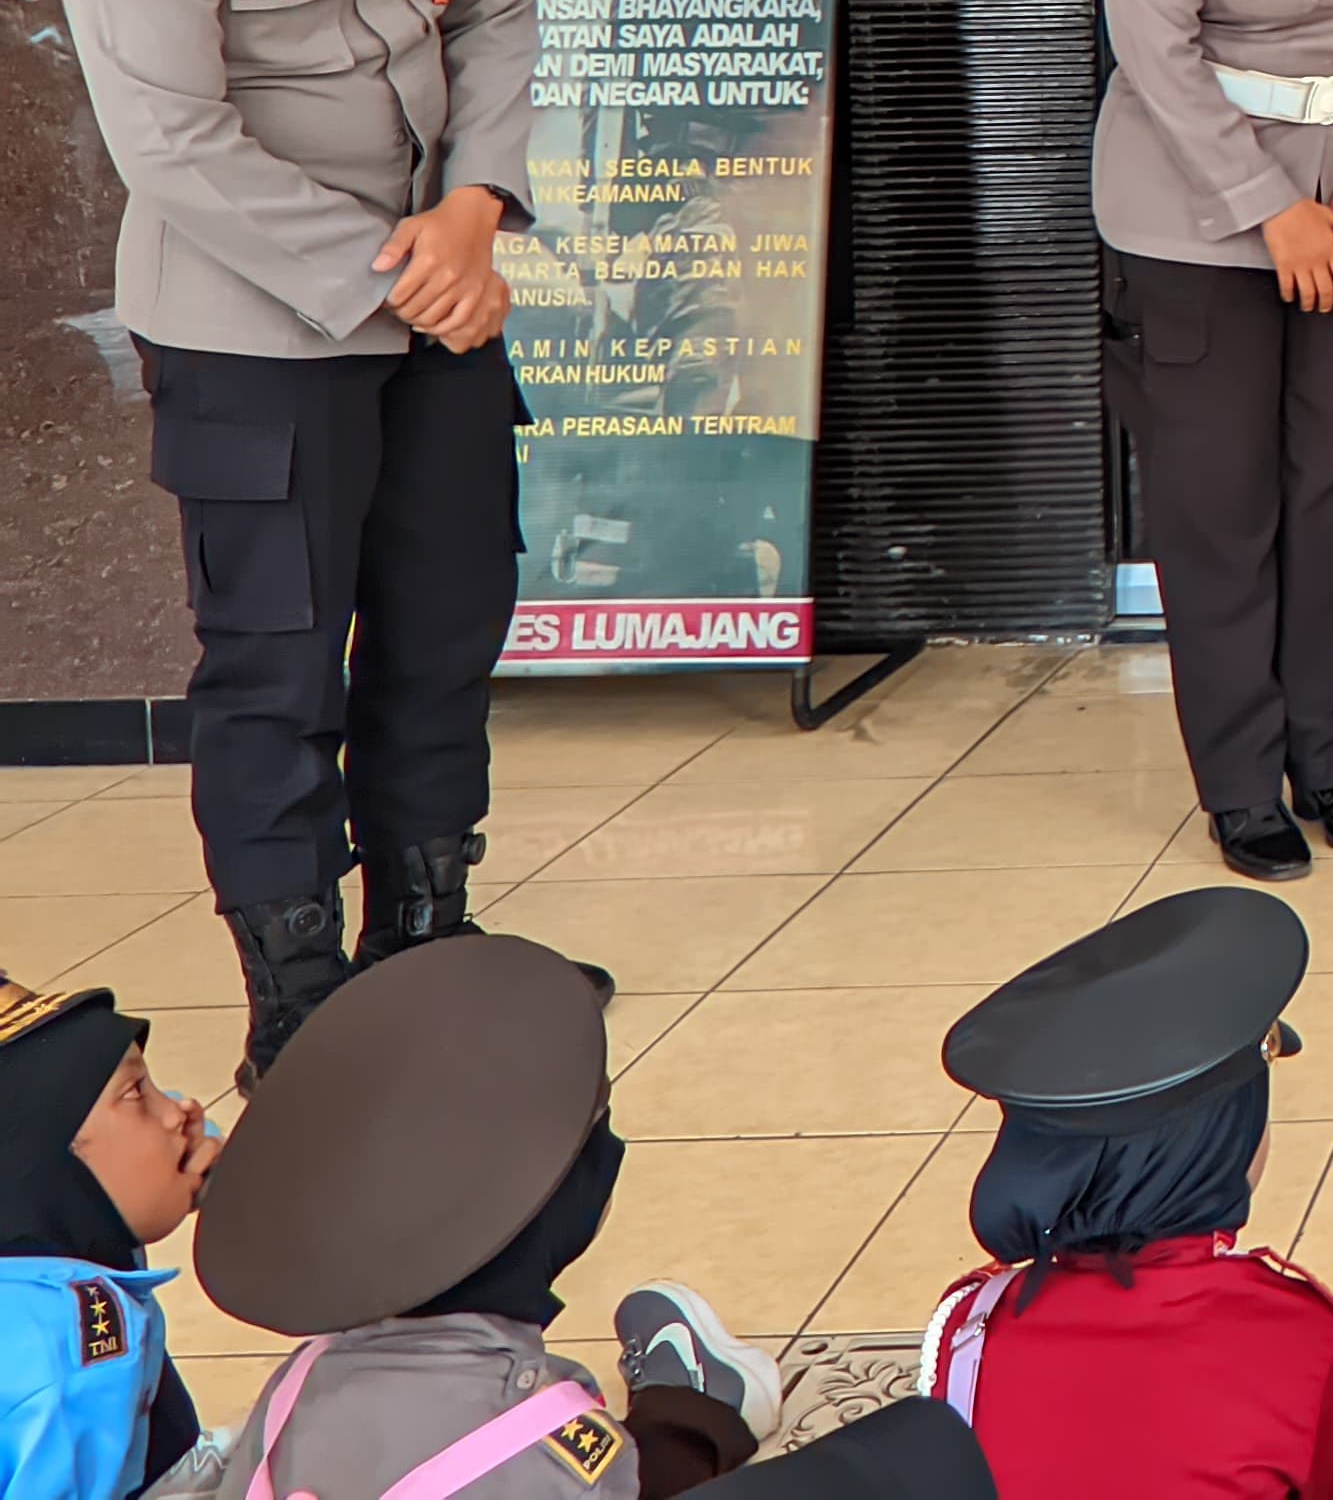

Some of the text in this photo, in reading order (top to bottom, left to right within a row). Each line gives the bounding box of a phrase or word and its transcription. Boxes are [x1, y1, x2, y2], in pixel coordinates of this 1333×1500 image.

[618, 24, 685, 48] SAYA
[692, 23, 799, 48] ADALAH
[569, 52, 634, 77] DEMI
[643, 51, 823, 80] MASYARAKAT,
[530, 80, 808, 107] DAN NEGARA UNTUK:
[604, 158, 702, 178] SEGALA
[716, 157, 814, 177] BENTUK
[555, 184, 686, 203] KEAMANAN.
[556, 234, 736, 255] KESELAMATAN
[750, 234, 809, 253] JIWA
[595, 261, 677, 280] BENDA
[692, 260, 741, 279] DAN
[757, 260, 807, 279] HAK
[509, 338, 802, 358] AMIN KEPASTIAN
[586, 364, 665, 384] HUKUM
[562, 417, 682, 436] PERASAAN
[691, 415, 796, 435] TENTRAM
[571, 612, 800, 651] LUMAJANG
[88, 1336, 118, 1357] TNI
